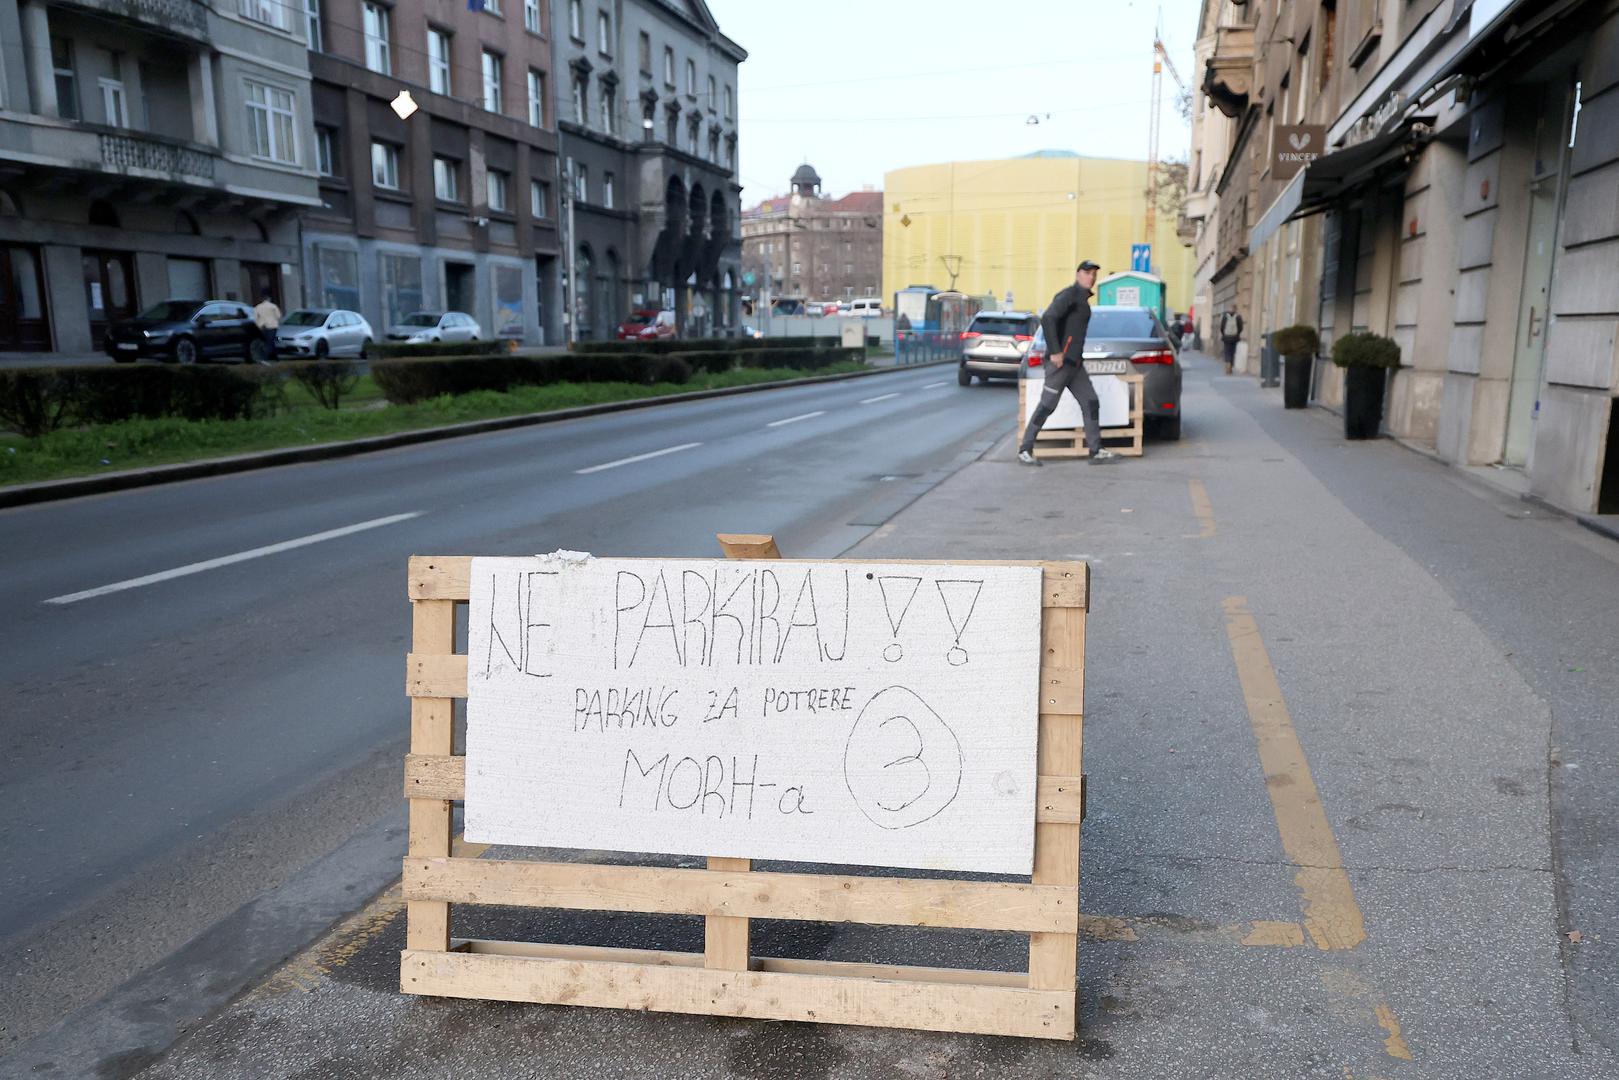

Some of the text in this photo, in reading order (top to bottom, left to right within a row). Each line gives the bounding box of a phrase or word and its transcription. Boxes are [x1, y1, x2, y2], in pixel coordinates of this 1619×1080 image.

[486, 571, 559, 680] NE
[574, 685, 679, 733] PARKING
[702, 686, 739, 723] ZA
[877, 715, 931, 812] 3
